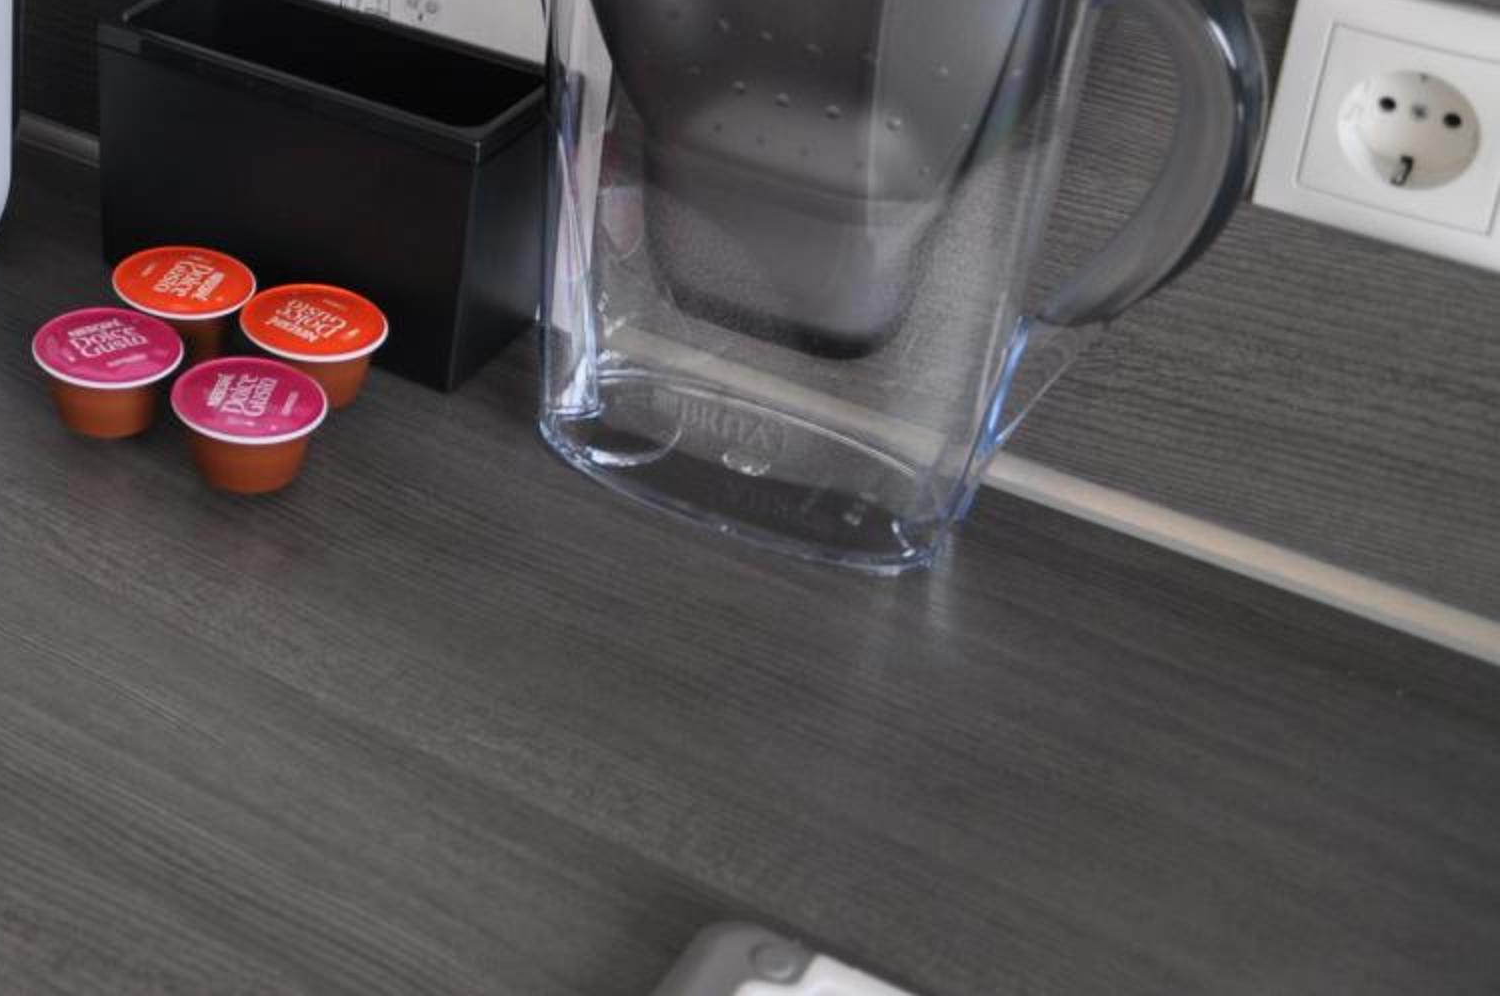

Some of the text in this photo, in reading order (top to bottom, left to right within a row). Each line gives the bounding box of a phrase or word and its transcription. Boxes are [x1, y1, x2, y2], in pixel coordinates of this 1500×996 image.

[68, 325, 137, 350] Dolce
[78, 334, 149, 357] Gusto
[220, 373, 259, 413] Dolce
[243, 376, 278, 417] Gusto
